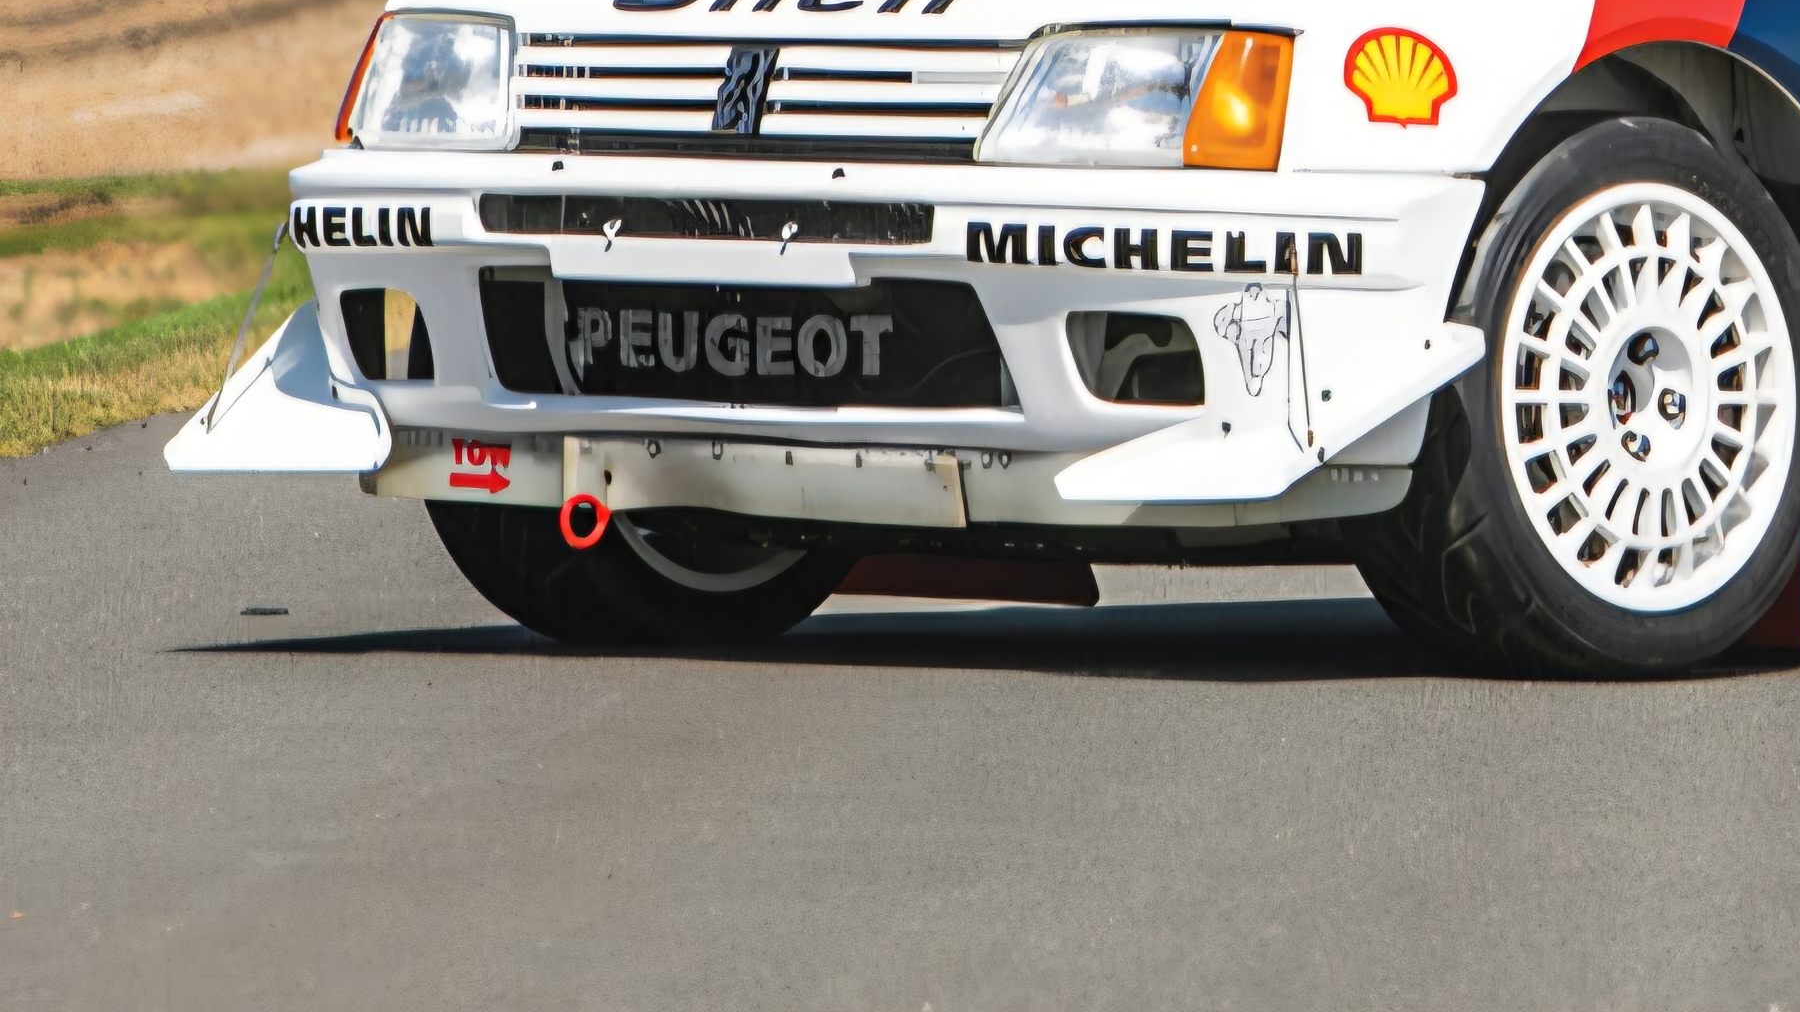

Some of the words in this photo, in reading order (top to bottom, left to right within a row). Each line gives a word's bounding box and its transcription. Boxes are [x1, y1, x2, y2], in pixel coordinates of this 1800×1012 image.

[291, 203, 434, 250] HELIN
[965, 220, 1365, 276] MICHELIN
[569, 305, 895, 379] PEUGEOT
[451, 437, 512, 468] TOW
